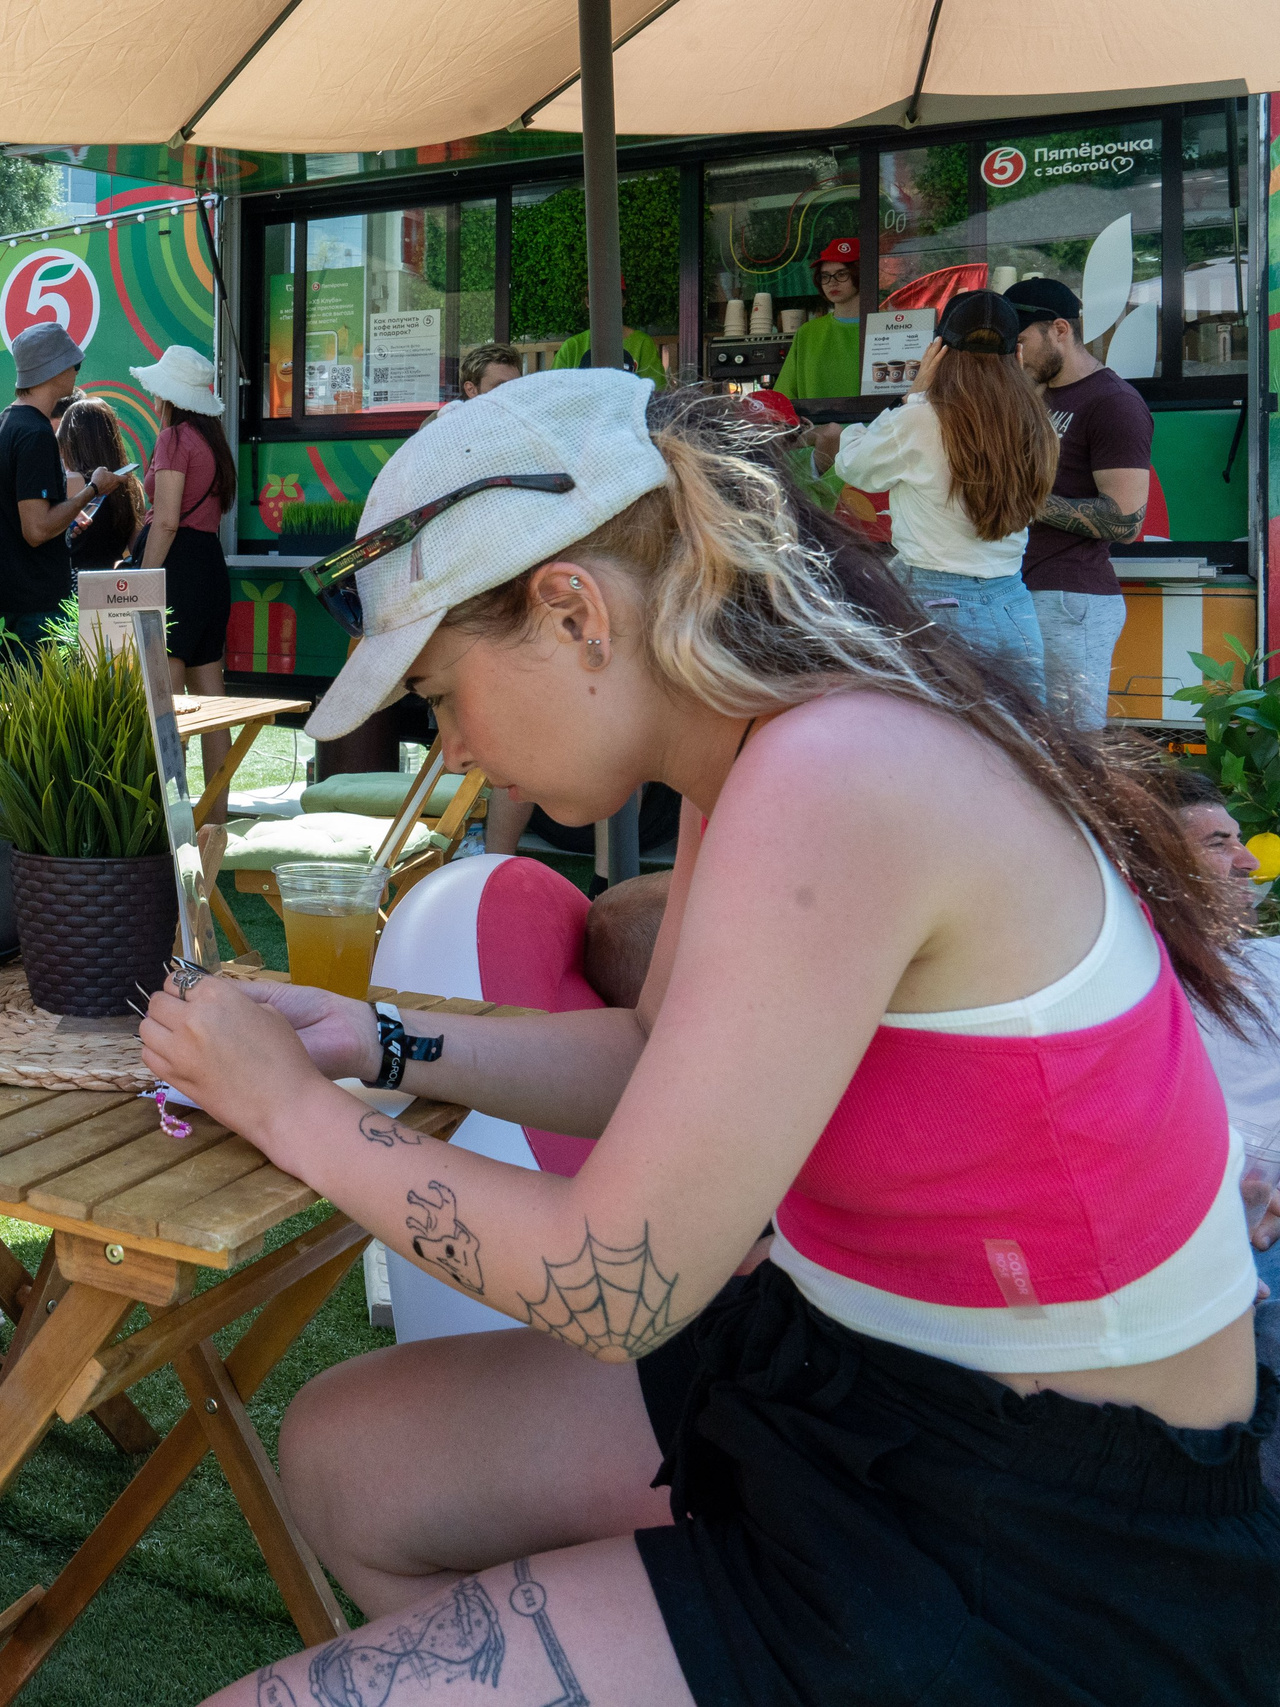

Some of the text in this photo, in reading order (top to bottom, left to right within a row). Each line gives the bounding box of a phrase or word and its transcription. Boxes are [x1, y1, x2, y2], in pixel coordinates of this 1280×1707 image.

[1034, 138, 1153, 162] Пятёрочка
[1034, 158, 1109, 177] с заботой
[387, 316, 420, 324] получить
[373, 323, 391, 331] кофе
[885, 323, 913, 331] Меню
[379, 329, 412, 337] подарок?
[336, 548, 366, 568] CHRISTIAN
[107, 594, 138, 604] Меню
[1007, 1252, 1029, 1295] COLOR
